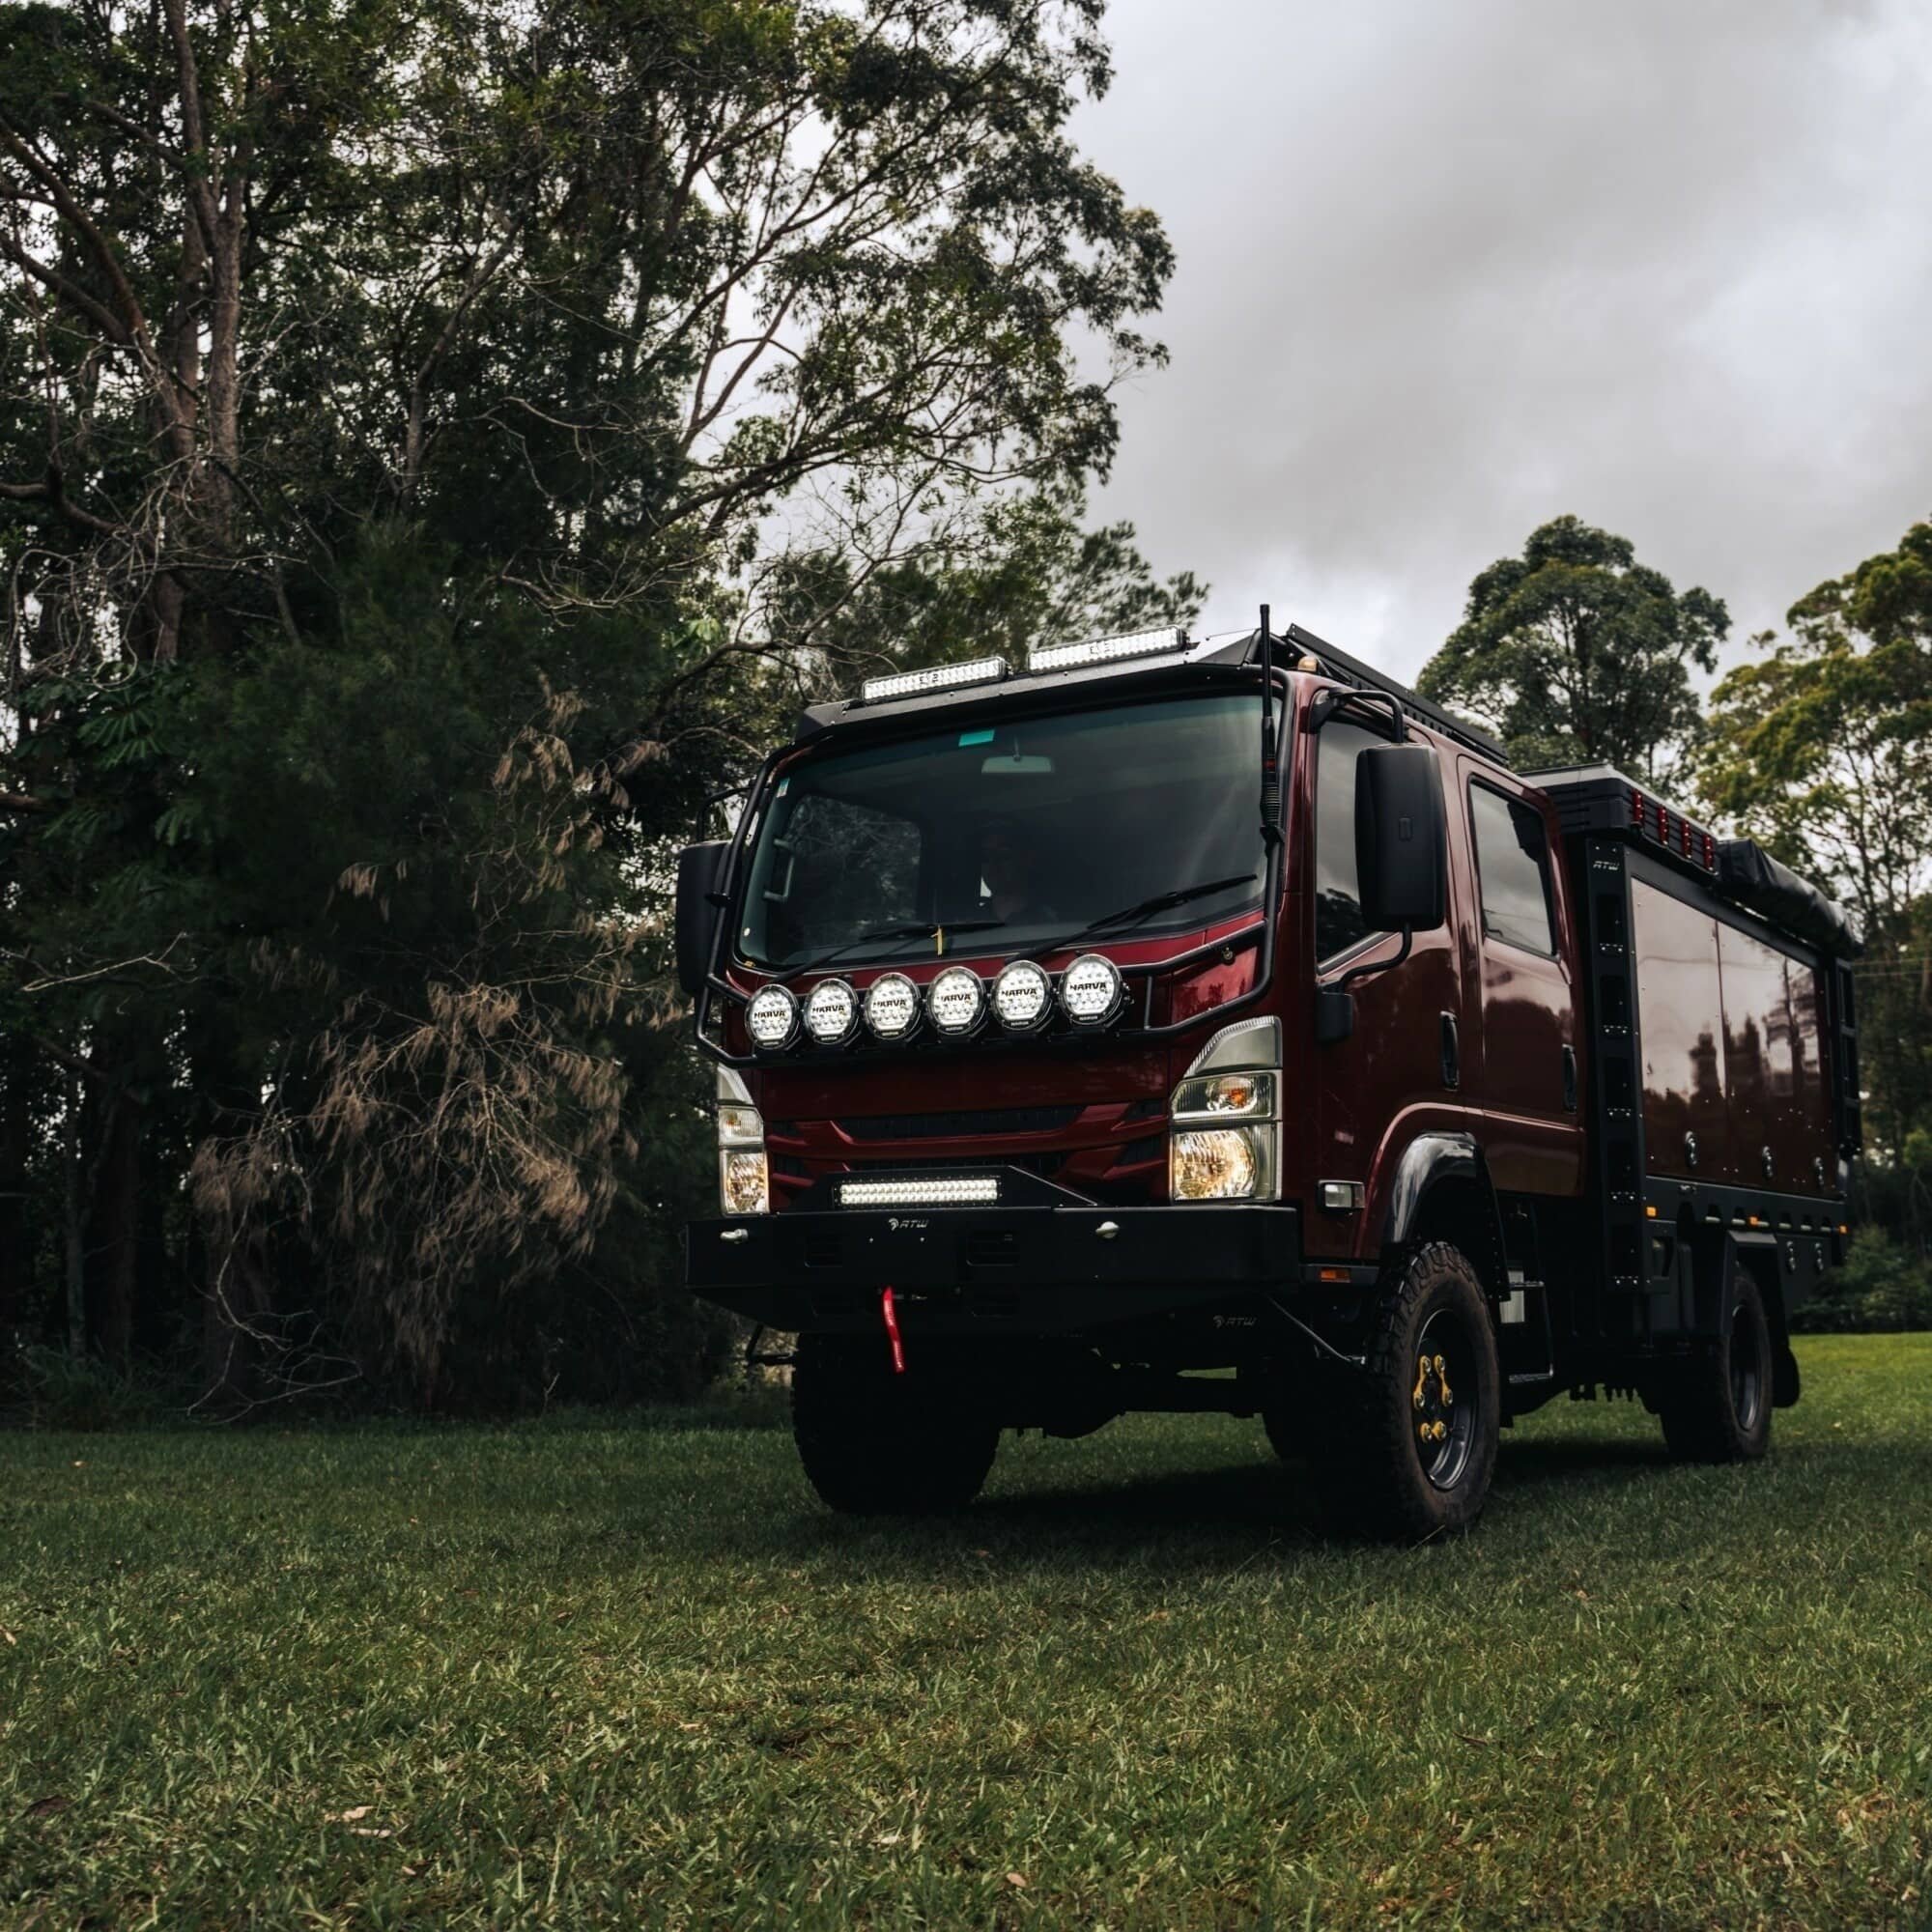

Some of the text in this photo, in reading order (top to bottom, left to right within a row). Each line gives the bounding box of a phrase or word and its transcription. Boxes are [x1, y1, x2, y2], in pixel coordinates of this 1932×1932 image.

[1069, 981, 1106, 991] NARVA
[1001, 987, 1037, 996] NARVA
[937, 993, 972, 1003] ARVA
[812, 1005, 845, 1013] NARVA
[753, 1010, 785, 1019] NARVA
[899, 1219, 929, 1229] ATW
